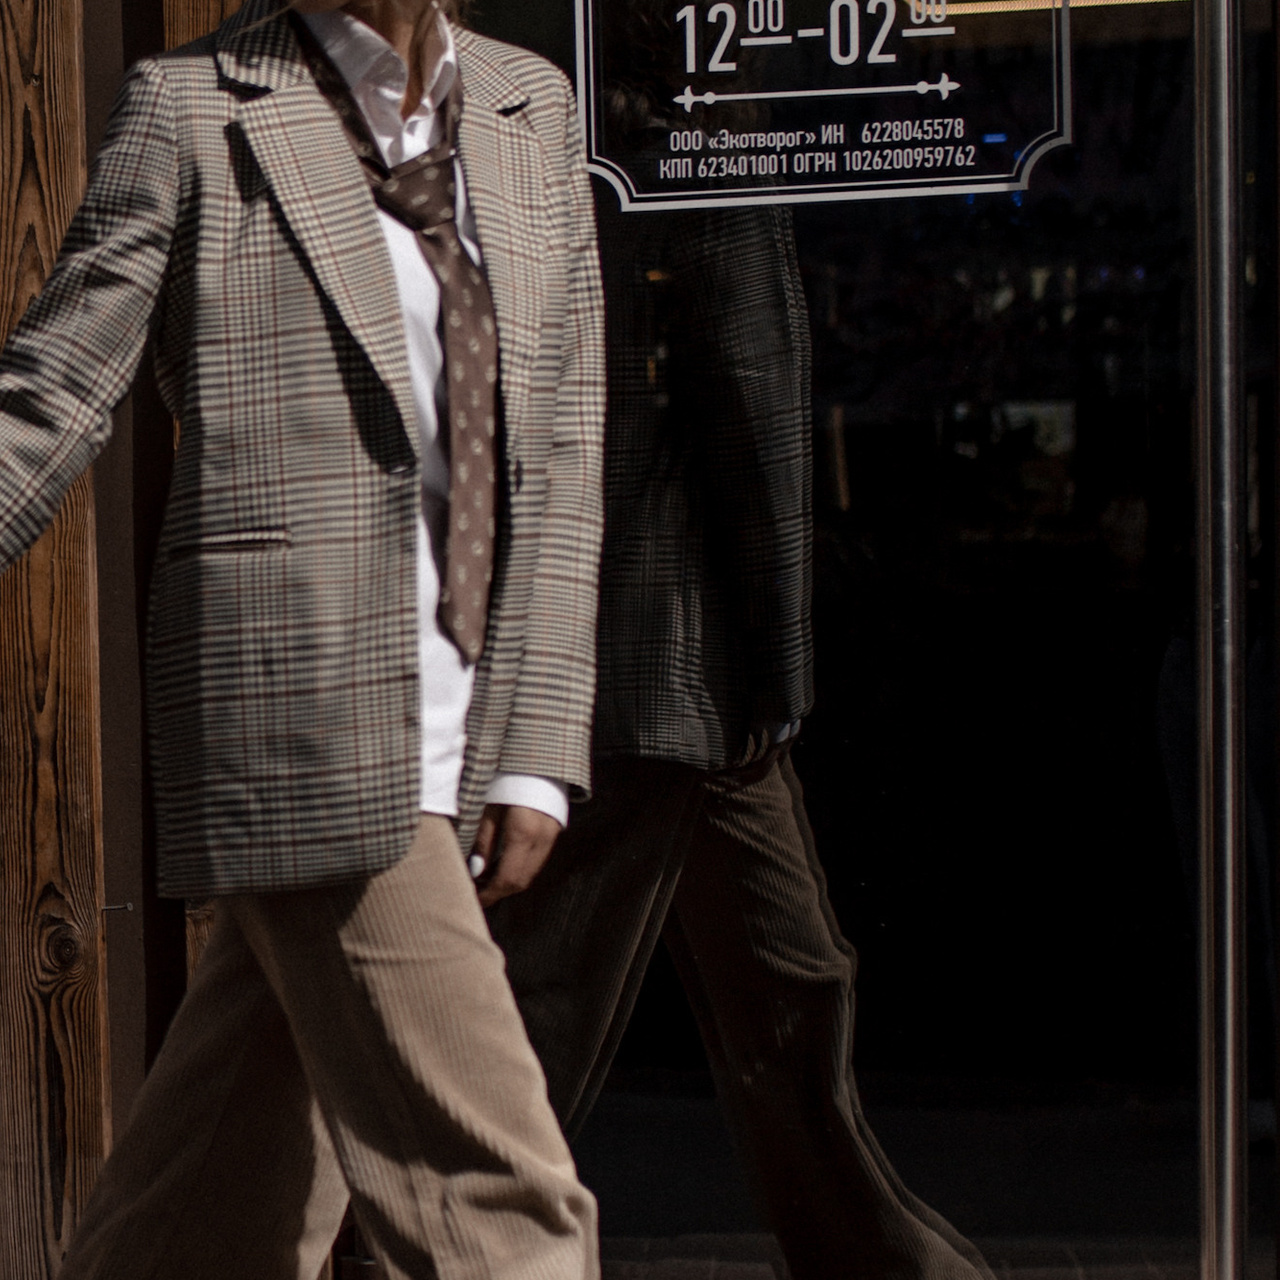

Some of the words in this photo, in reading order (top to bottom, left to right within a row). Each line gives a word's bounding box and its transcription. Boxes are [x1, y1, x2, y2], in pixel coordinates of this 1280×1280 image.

[670, 130, 702, 152] ООО
[708, 128, 816, 152] «Экотворог»
[862, 118, 965, 144] 6228045578
[660, 158, 693, 179] КПП
[698, 154, 788, 178] 623401001
[794, 152, 836, 174] ОГРН
[843, 145, 976, 171] 1026200959762
